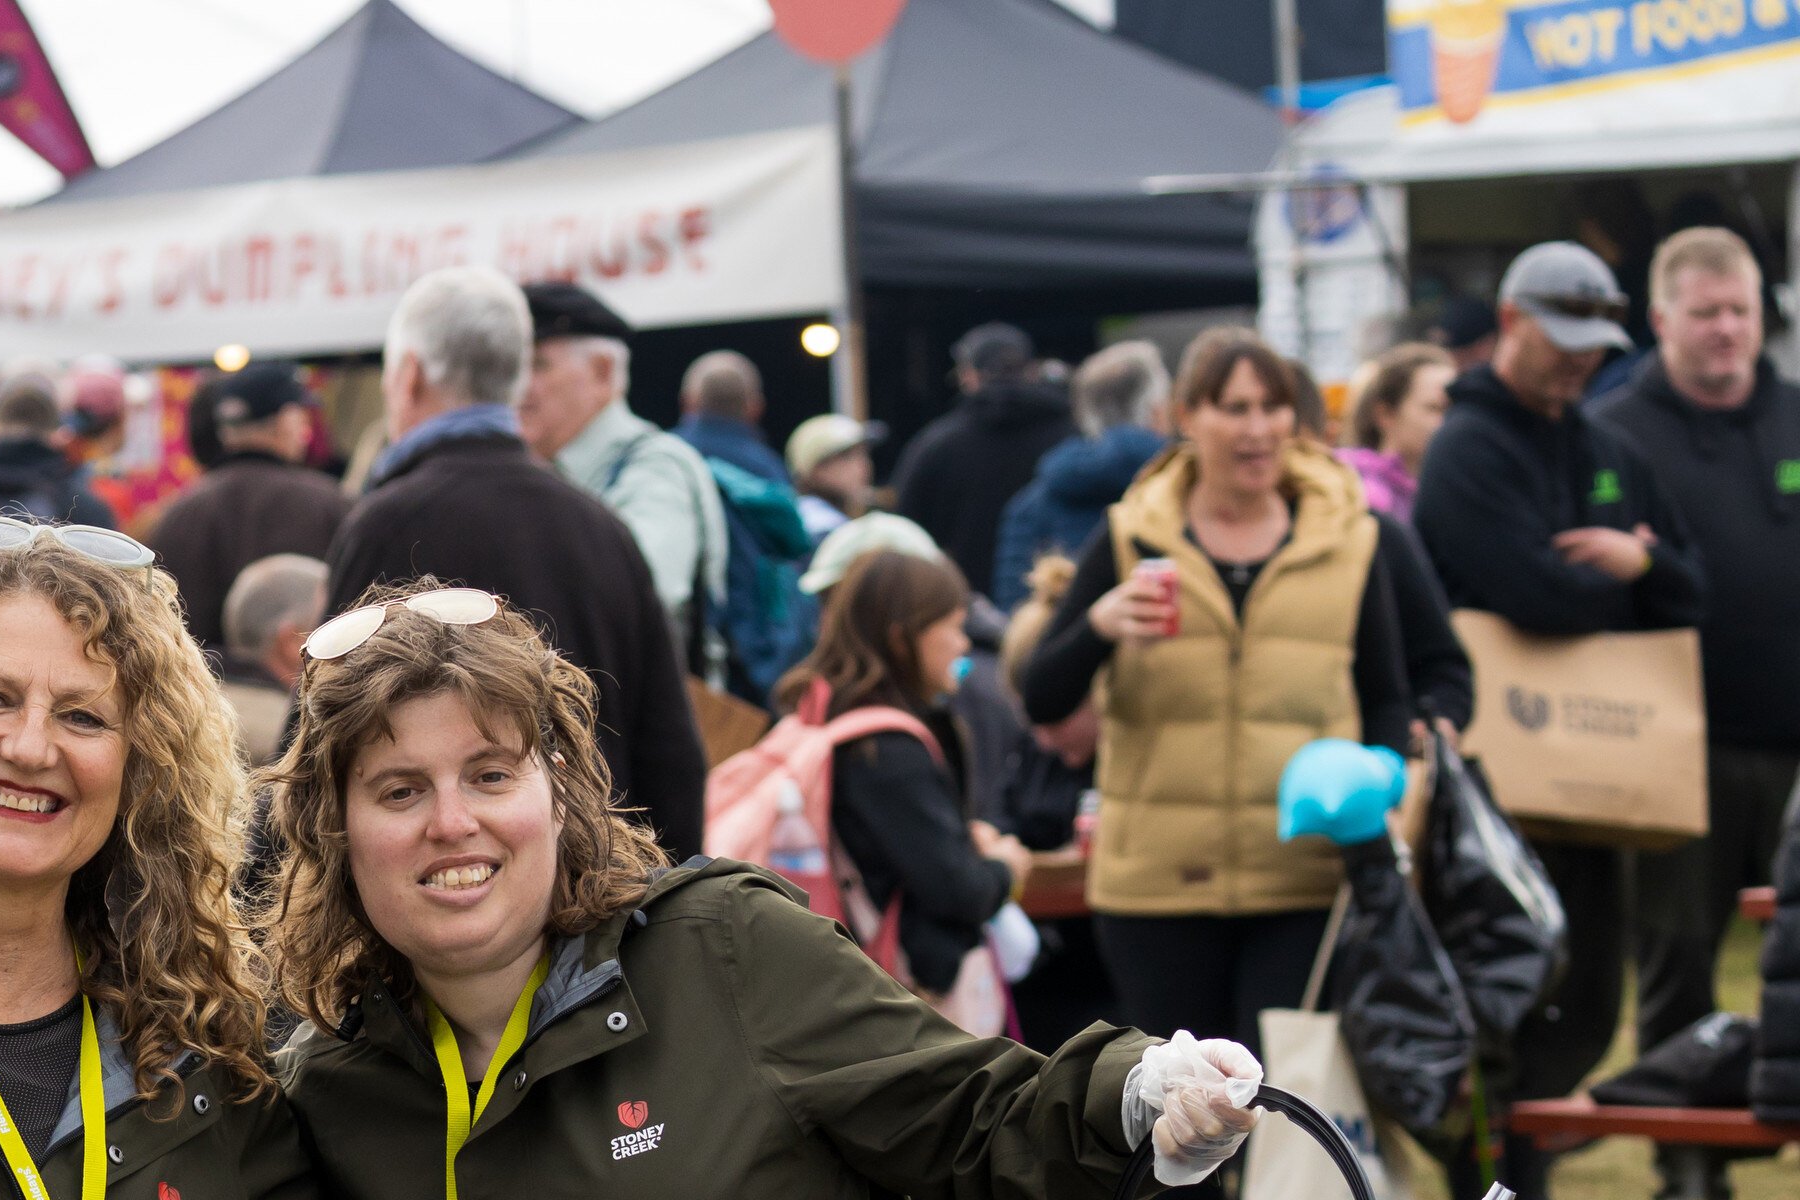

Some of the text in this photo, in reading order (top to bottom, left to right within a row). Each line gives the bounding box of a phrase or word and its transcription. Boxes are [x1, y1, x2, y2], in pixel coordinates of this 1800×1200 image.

[1524, 8, 1624, 71] HOT
[1630, 0, 1747, 57] FOOD
[155, 222, 466, 308] DUMPLING
[500, 203, 712, 284] HOUSE
[610, 1123, 665, 1150] STONEY
[612, 1138, 659, 1160] CREEK
